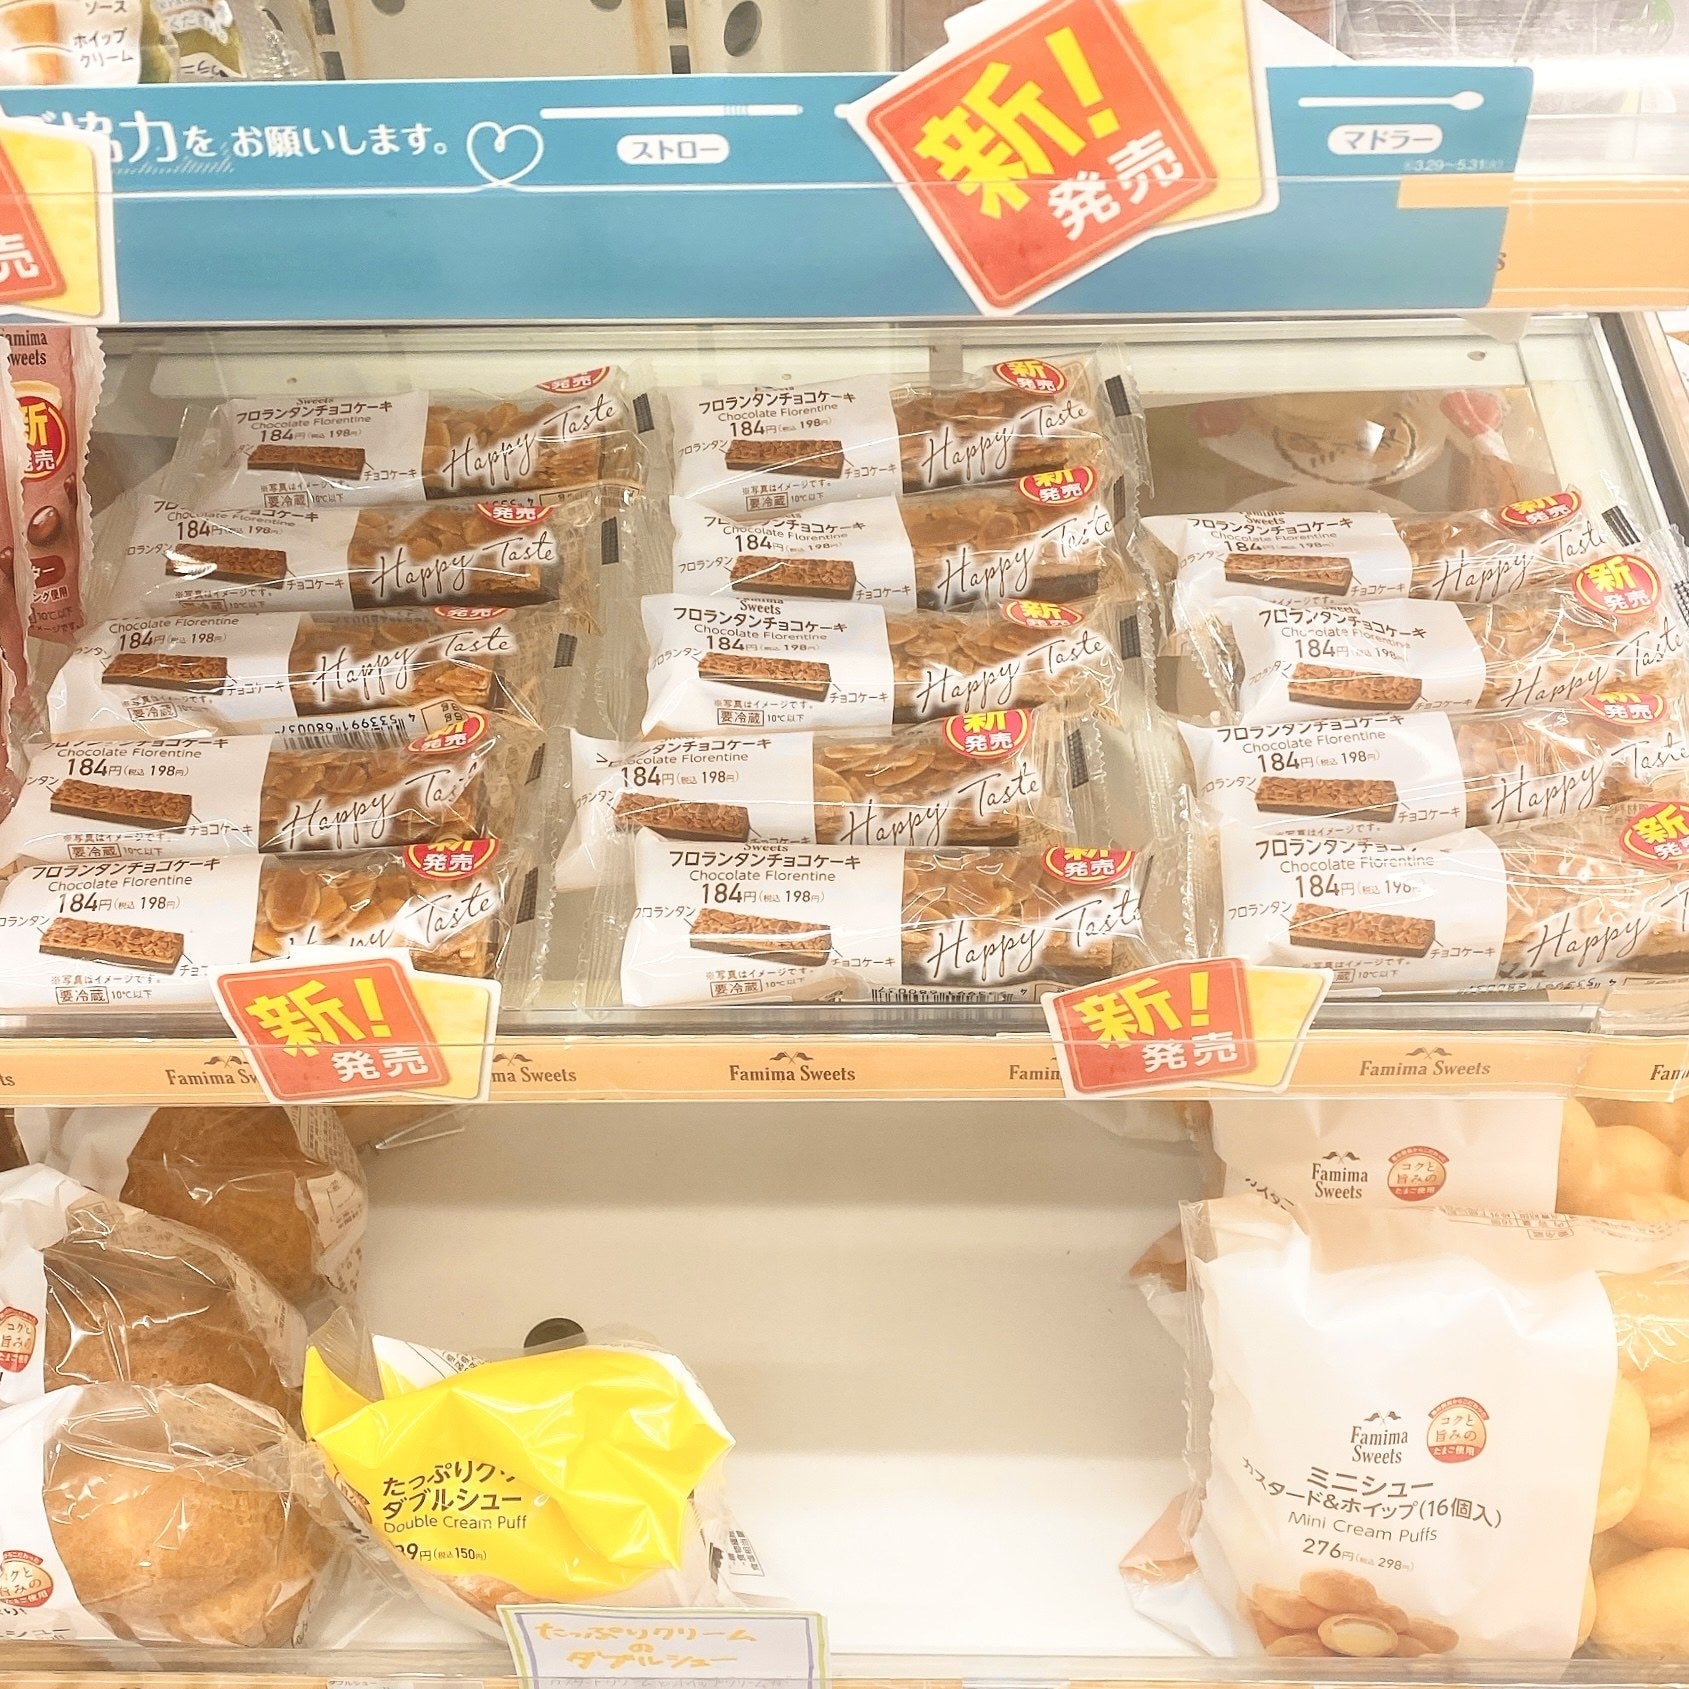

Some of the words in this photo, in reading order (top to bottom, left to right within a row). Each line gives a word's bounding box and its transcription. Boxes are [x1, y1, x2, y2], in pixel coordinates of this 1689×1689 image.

[72, 28, 126, 49] ホイップ
[79, 50, 134, 69] クリーム
[914, 26, 1121, 220] 新!
[230, 123, 448, 158] お願いします。
[1345, 129, 1435, 151] マドラー
[631, 140, 720, 161] ストロー
[1048, 128, 1184, 241] 発売
[3, 331, 48, 347] amima
[9, 349, 48, 366] weets
[1006, 358, 1047, 379] 新
[1016, 377, 1057, 392] 発売
[698, 390, 856, 414] フロランタンチョコケーキ
[718, 409, 778, 422] Chocolate
[780, 402, 838, 417] Florentine
[236, 400, 393, 425] フロランタンチョコケーキ
[250, 419, 310, 431] Chocolate
[313, 415, 372, 426] Florentine
[442, 430, 538, 488] Happy
[543, 393, 616, 443] Taste
[678, 439, 729, 458] フロランタン
[921, 426, 1014, 484] Happy
[1020, 399, 1088, 438] Taste
[363, 469, 417, 481] チョコケーキ
[844, 463, 898, 480] チョコケーキ
[749, 494, 787, 510] 要冷蔵
[1039, 483, 1083, 503] 発売
[493, 506, 538, 521] 発売
[1525, 504, 1571, 524] 発売
[1187, 517, 1354, 536] フロランタンチョコケーキ
[1210, 529, 1273, 542] Chocolate
[371, 547, 475, 598] Happy
[482, 530, 555, 568] Taste
[678, 556, 734, 574] フロランタン
[1581, 555, 1638, 593] 新
[286, 578, 345, 591] チョコケーキ
[937, 547, 1035, 605] Happy
[1432, 549, 1535, 602] Happy
[855, 585, 912, 600] チョコケーキ
[1351, 584, 1406, 597] チョコケーキ
[739, 601, 782, 616] Sweets
[1019, 600, 1062, 620] 新
[1602, 590, 1652, 613] 発売
[108, 620, 172, 634] Chocolate
[175, 616, 240, 627] Florentine
[673, 606, 848, 633] フロランタンチョコケーキ
[694, 623, 759, 639] Chocolate
[763, 630, 828, 641] Florentine
[313, 647, 420, 703] Happy
[428, 626, 512, 657] Taste
[915, 663, 1021, 714] Happy
[1027, 630, 1105, 674] Taste
[1500, 665, 1610, 708] Happy
[1616, 616, 1684, 676] Taste
[830, 690, 889, 705] チョコケーキ
[720, 710, 762, 724] 要冷蔵
[767, 713, 805, 723] 10℃以下
[1603, 703, 1653, 719] 発売
[963, 711, 1007, 732] 新
[1217, 714, 1405, 743] フロランタンチョコケーキ
[965, 731, 1014, 752] 発売
[1243, 737, 1313, 754] Chocolate
[1316, 730, 1387, 746] Florentine
[57, 748, 128, 758] Chocolate
[132, 748, 202, 759] Florentine
[682, 752, 748, 764] Florentine
[150, 765, 190, 778] 198円)
[702, 770, 740, 784] 198円)
[839, 798, 950, 845] Happy
[958, 762, 1040, 816] Taste
[1491, 764, 1607, 824] Happy
[281, 792, 396, 850] Happy
[1398, 808, 1462, 824] チョコケーキ
[1631, 803, 1686, 844] 新
[72, 846, 119, 858] 要冷蔵
[668, 849, 862, 870] フロランタンチョコケーキ
[32, 857, 221, 880] フロランタンチョコケーキ
[423, 853, 474, 872] 発売
[1064, 858, 1116, 878] 発売
[1279, 857, 1357, 874] Chocolate
[48, 877, 119, 893] Chocolate
[122, 874, 194, 888] Florentine
[689, 869, 761, 882] Chocolate
[765, 869, 836, 882] Florentine
[140, 895, 182, 911] 198円)
[785, 889, 825, 903] 198円)
[405, 881, 495, 943] Taste
[634, 904, 697, 919] フロランタン
[1228, 900, 1293, 920] フロランタン
[1527, 912, 1651, 968] Happy
[926, 920, 1046, 982] Happy
[1430, 946, 1496, 960] チョコケーキ
[831, 956, 896, 968] チョコケーキ
[60, 989, 106, 1002] 要冷蔵
[111, 989, 153, 1000] 10℃以下
[713, 981, 760, 996] 要冷蔵
[245, 976, 391, 1058] 新!
[1071, 971, 1210, 1050] 新!
[1141, 1031, 1239, 1074] 発売
[330, 1045, 430, 1083] 発売
[729, 1065, 796, 1082] Famima
[800, 1065, 856, 1082] Sweets
[1359, 1060, 1428, 1077] Famima
[1432, 1059, 1492, 1076] Sweets
[165, 1069, 235, 1087] Famima
[520, 1067, 577, 1084] Sweets
[1311, 1162, 1369, 1183] Famima
[1402, 1161, 1436, 1172] コクと
[1314, 1180, 1363, 1200] Sweets
[1441, 1414, 1474, 1427] コクと
[1350, 1425, 1409, 1445] Famima
[1351, 1445, 1403, 1465] Sweets
[382, 1460, 516, 1497] たっぷりク
[1306, 1466, 1434, 1498] ミニシュー
[382, 1487, 522, 1519] ダブルシュー
[383, 1515, 438, 1534] Double
[442, 1515, 492, 1530] Cream
[497, 1515, 528, 1530] Puff
[1288, 1511, 1327, 1530] Mini
[1333, 1519, 1393, 1542] Cream
[1399, 1526, 1438, 1543] Puffs
[454, 1546, 487, 1561] 150円)
[535, 1622, 758, 1642] たっぷりクリーム
[628, 1643, 654, 1654] の
[566, 1651, 738, 1669] ダブルシュー
